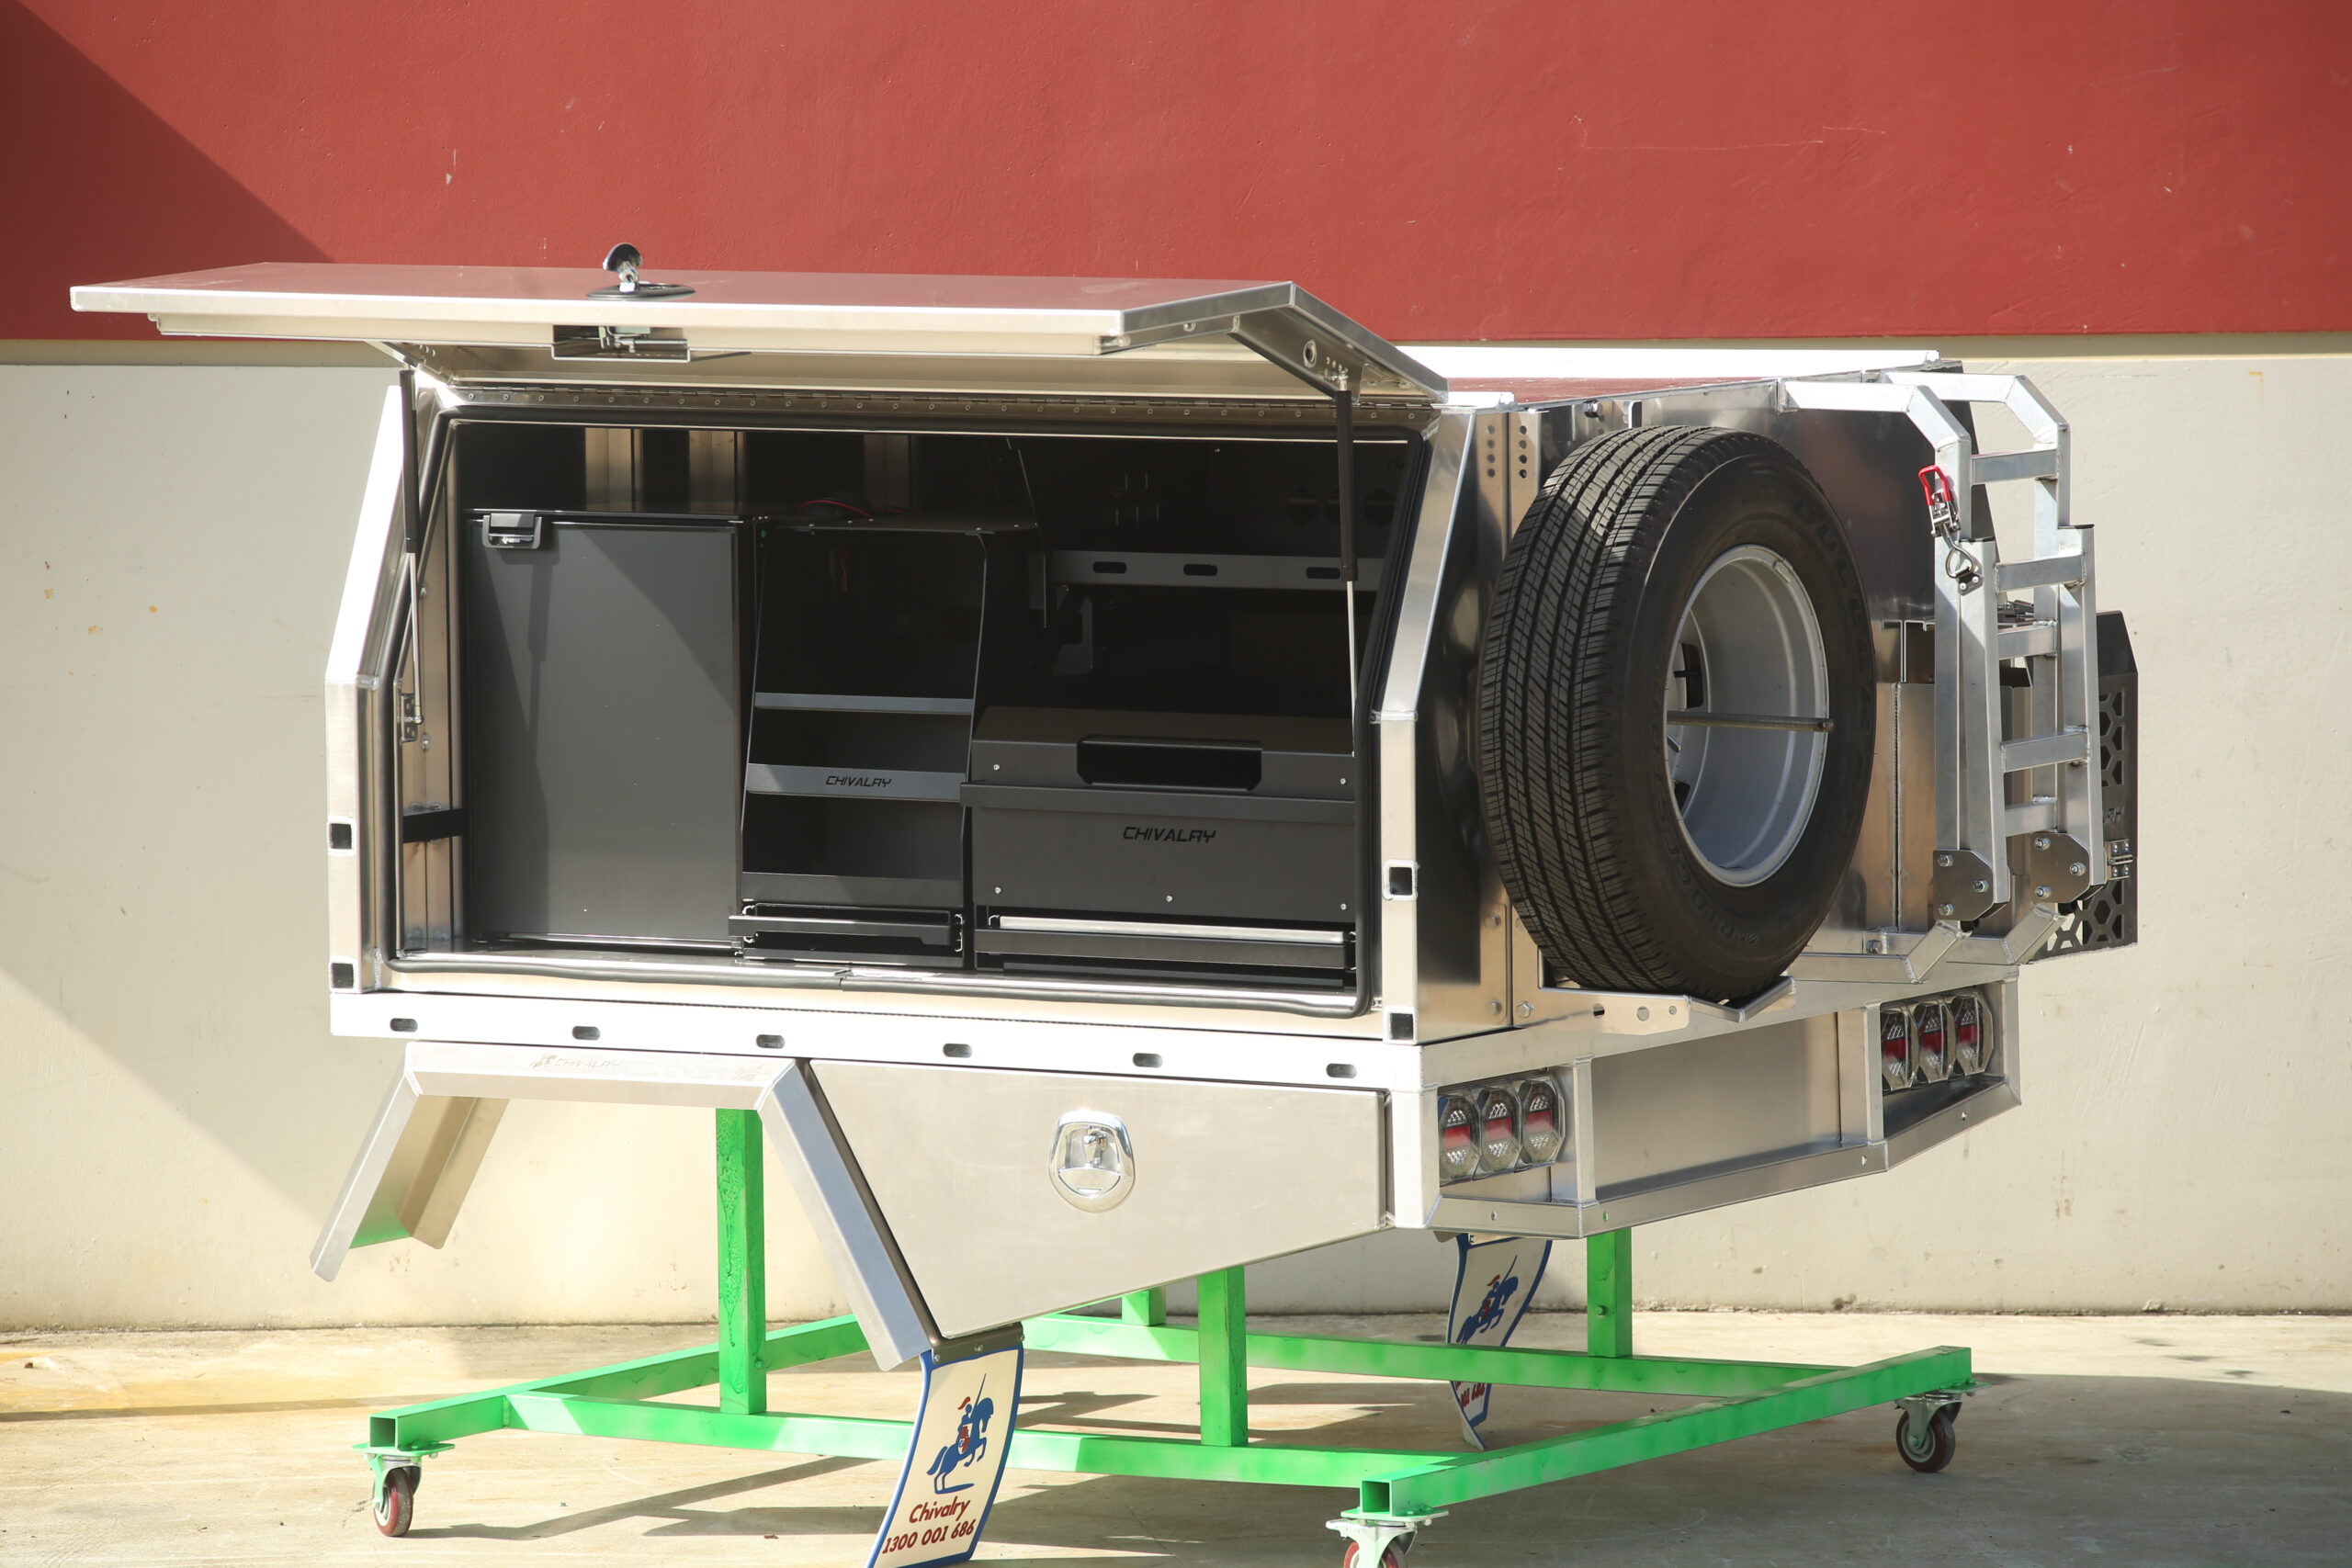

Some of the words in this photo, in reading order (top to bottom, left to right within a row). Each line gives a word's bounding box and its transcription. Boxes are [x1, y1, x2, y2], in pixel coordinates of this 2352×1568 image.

[826, 775, 892, 788] CHIVALRY
[1123, 826, 1217, 843] CHIVALRY
[909, 1495, 971, 1524] Chivalry
[882, 1531, 918, 1554] 1300
[921, 1525, 949, 1545] 001
[951, 1518, 977, 1539] 686
